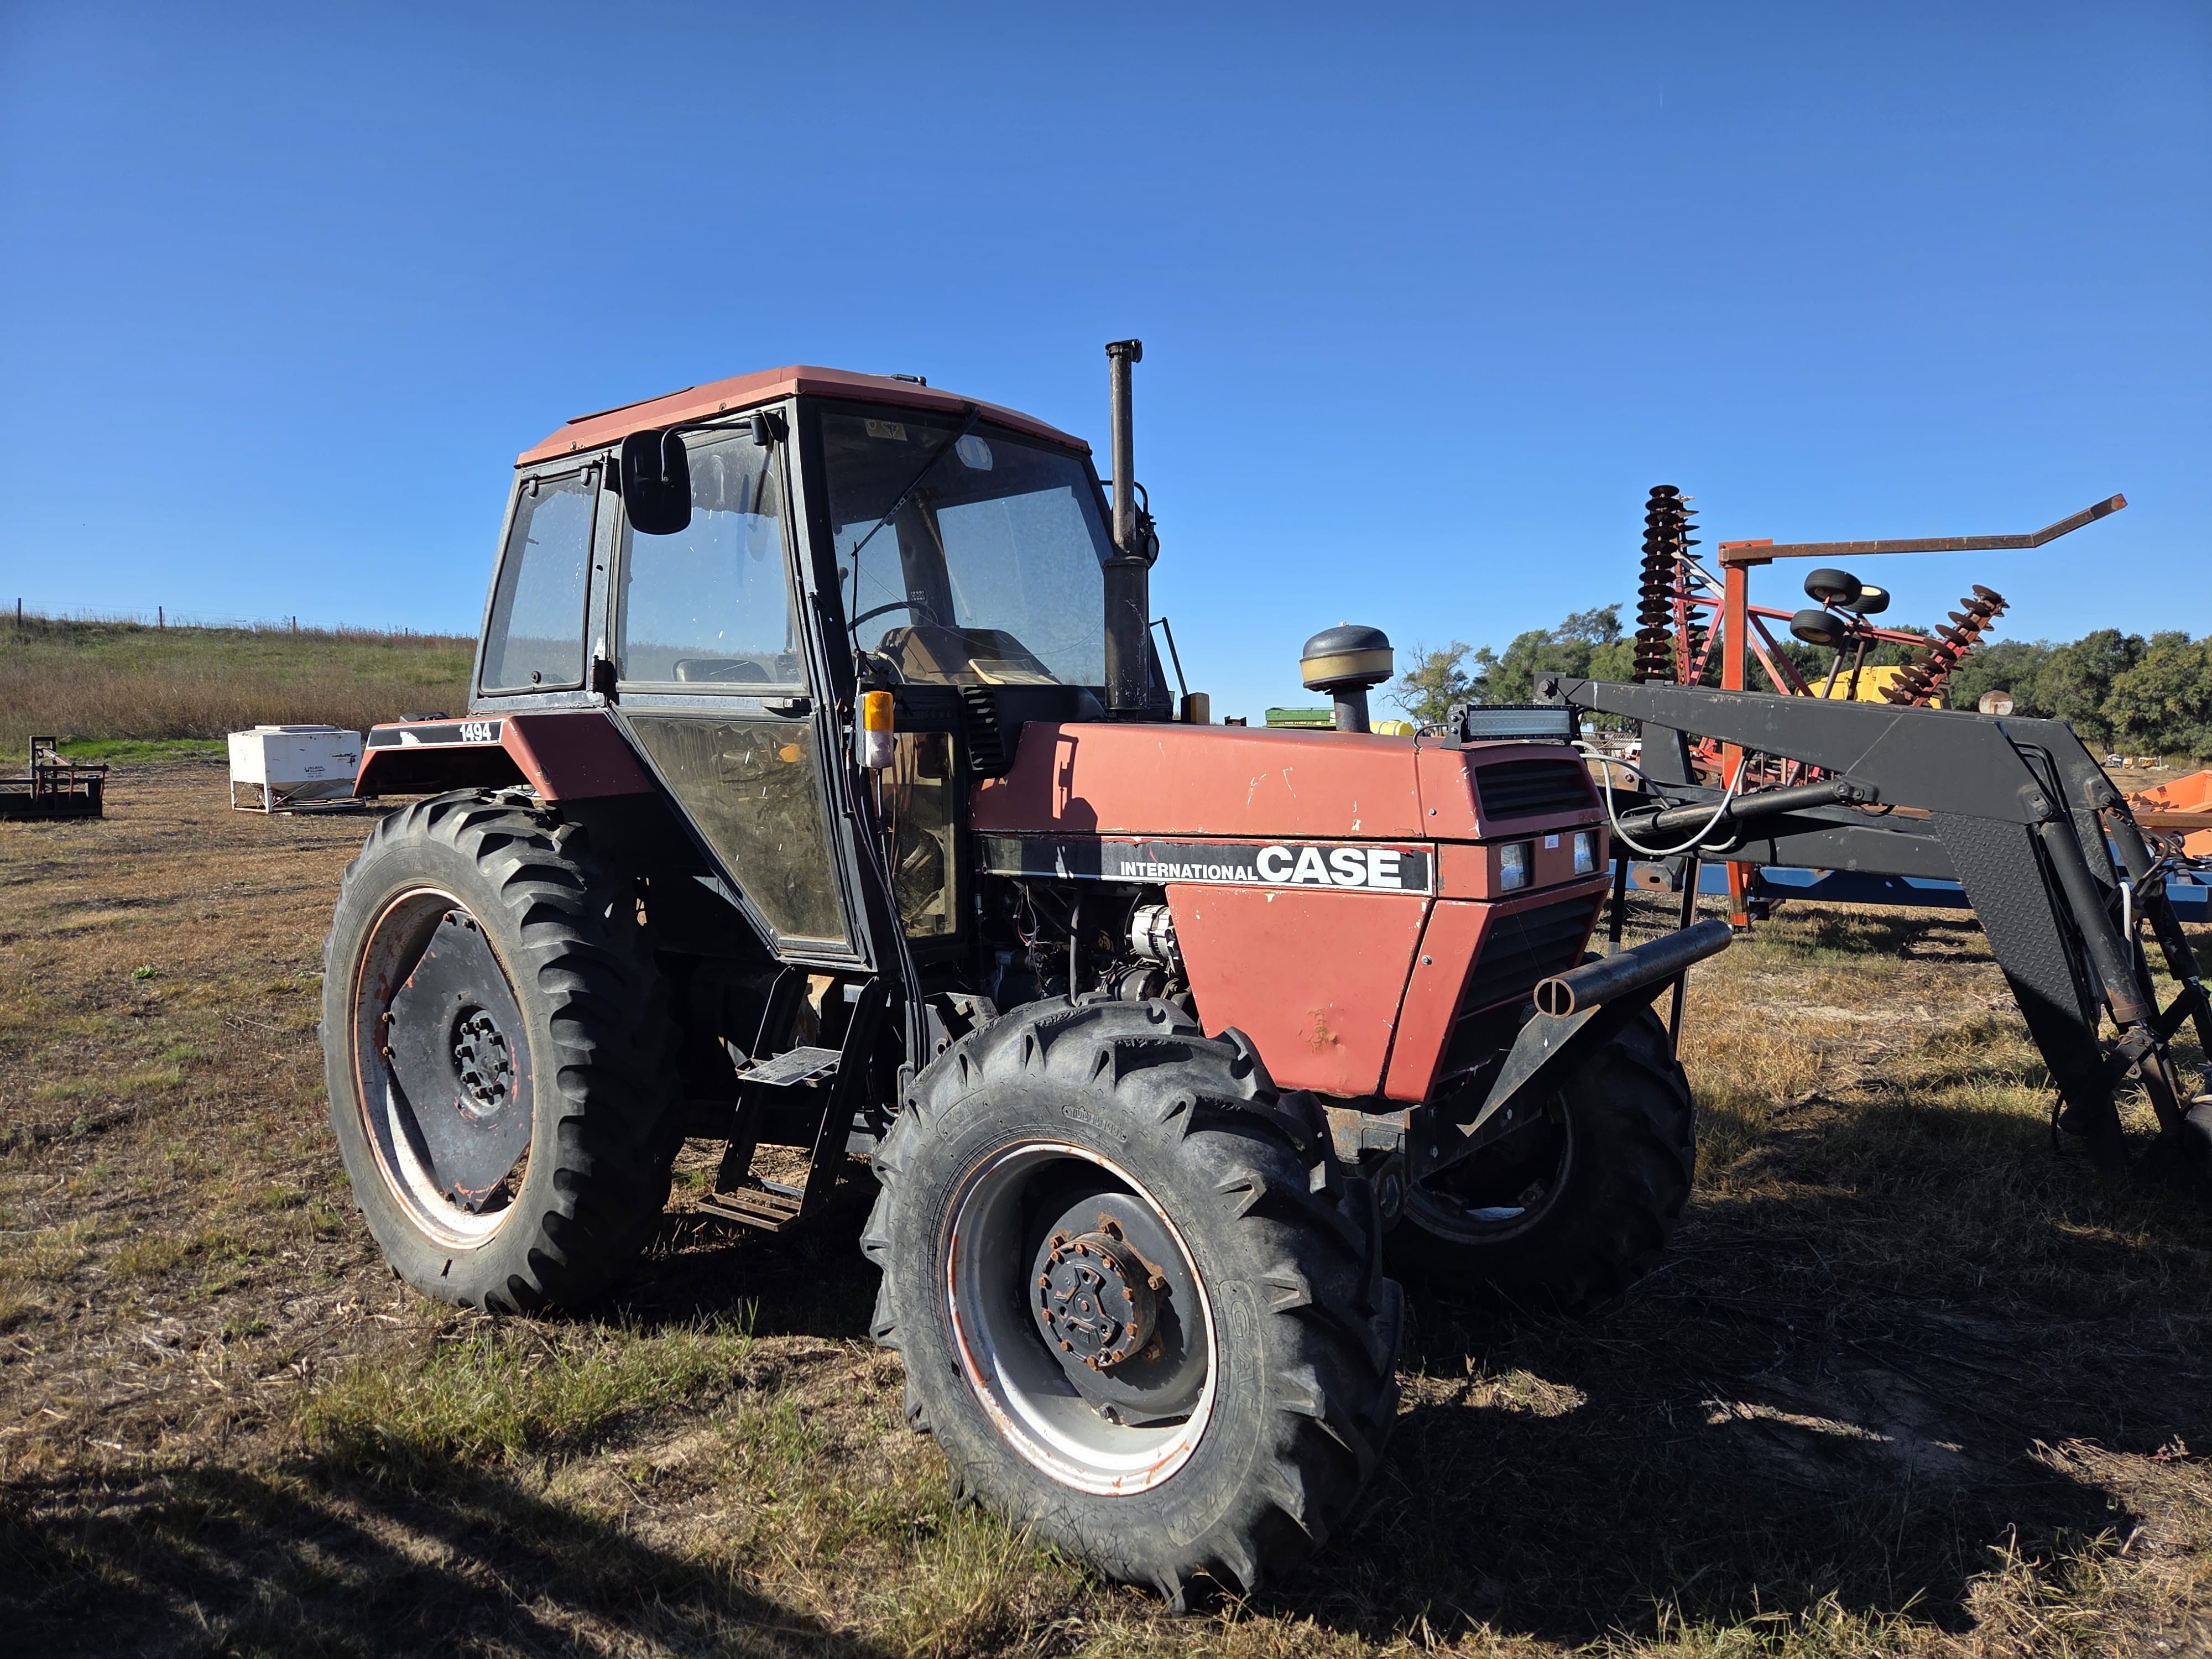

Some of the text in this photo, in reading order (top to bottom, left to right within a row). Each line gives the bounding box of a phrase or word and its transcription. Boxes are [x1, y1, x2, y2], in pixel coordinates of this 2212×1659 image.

[460, 723, 492, 742] 1494
[1120, 846, 1401, 888] INTERNATIONAL CASE
